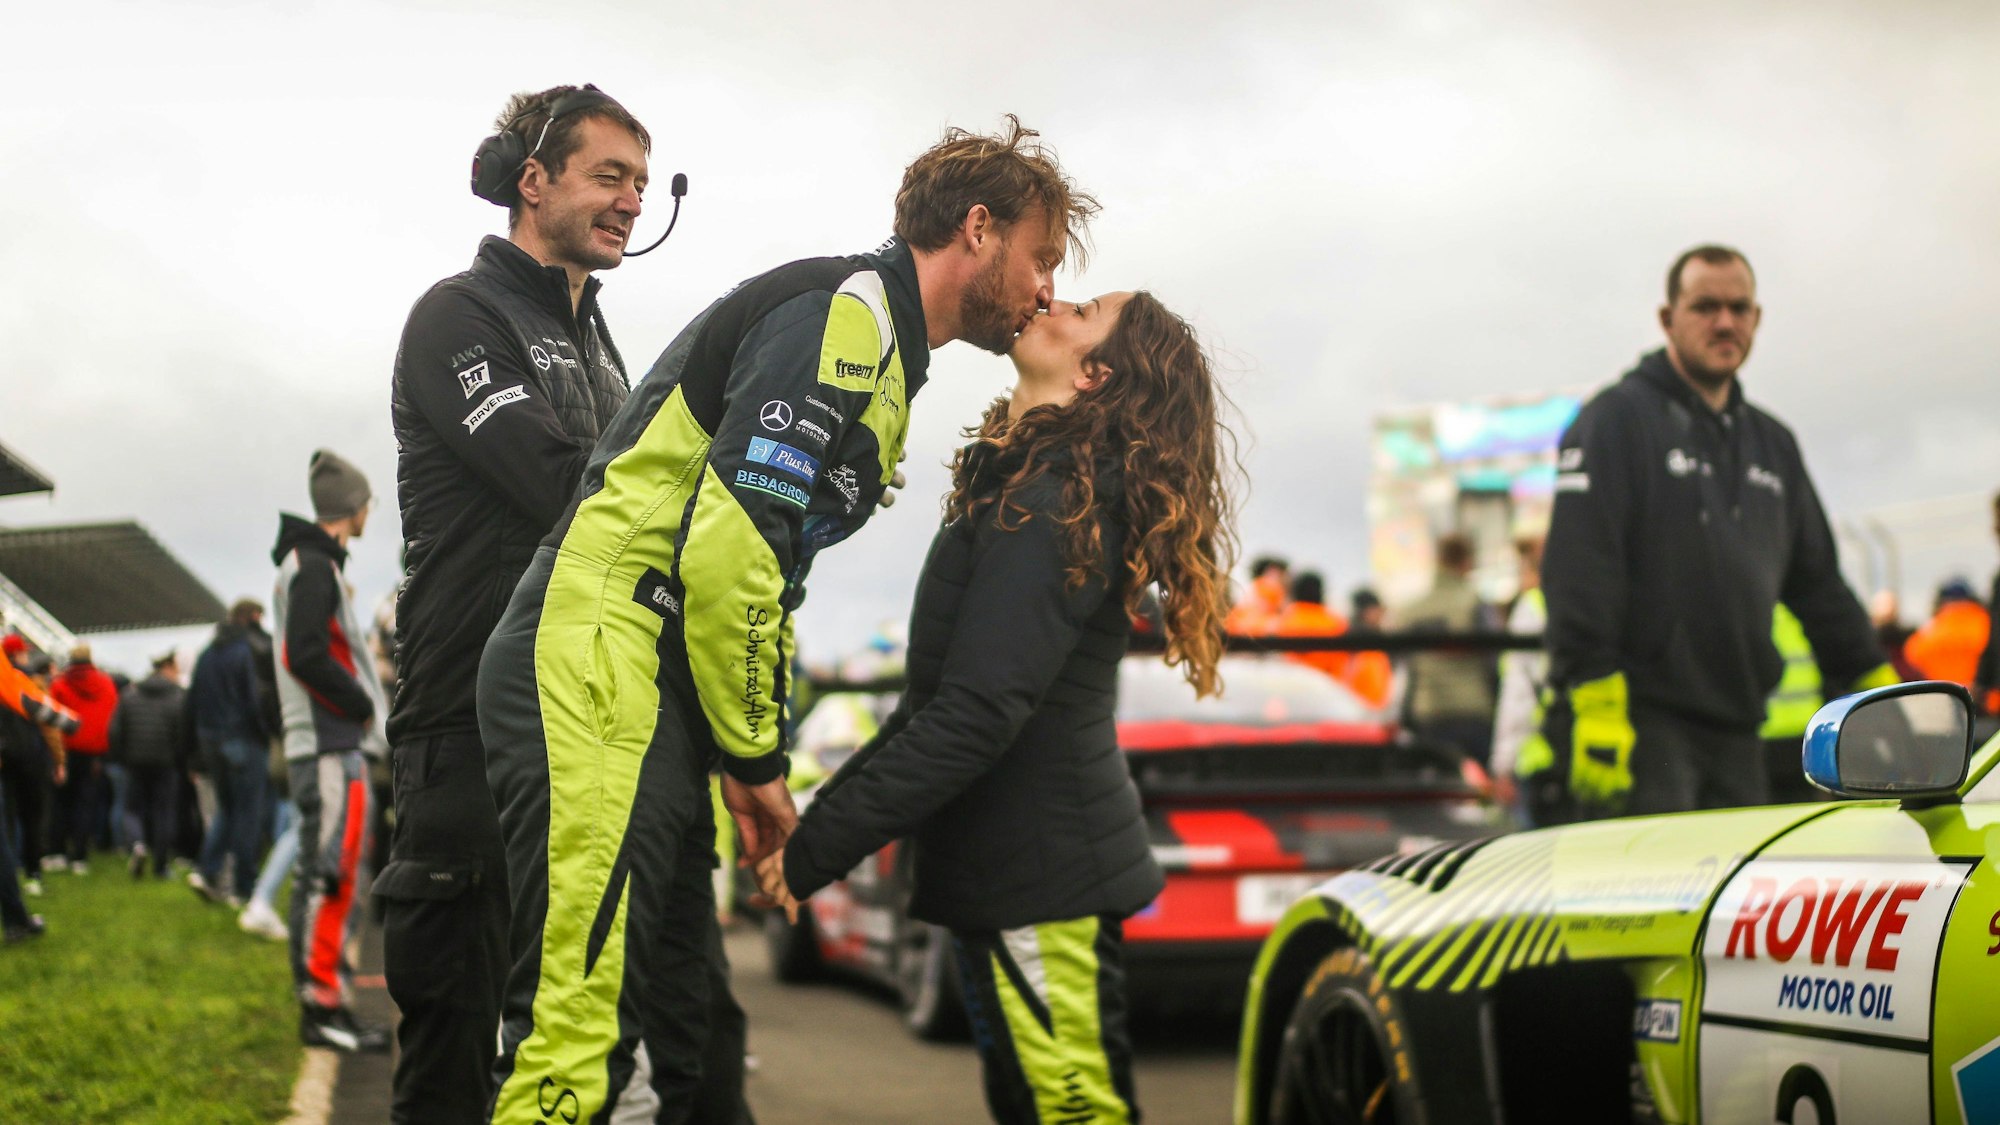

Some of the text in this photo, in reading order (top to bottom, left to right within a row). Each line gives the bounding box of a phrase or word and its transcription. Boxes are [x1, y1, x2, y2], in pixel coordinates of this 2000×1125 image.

[452, 344, 485, 368] JAKO
[835, 357, 875, 379] freem
[469, 388, 522, 426] RAVENOL
[805, 394, 844, 424] Customer Racing
[652, 585, 679, 616] free
[1725, 876, 1929, 972] ROWE
[1778, 974, 1895, 1021] MOTOR OIL
